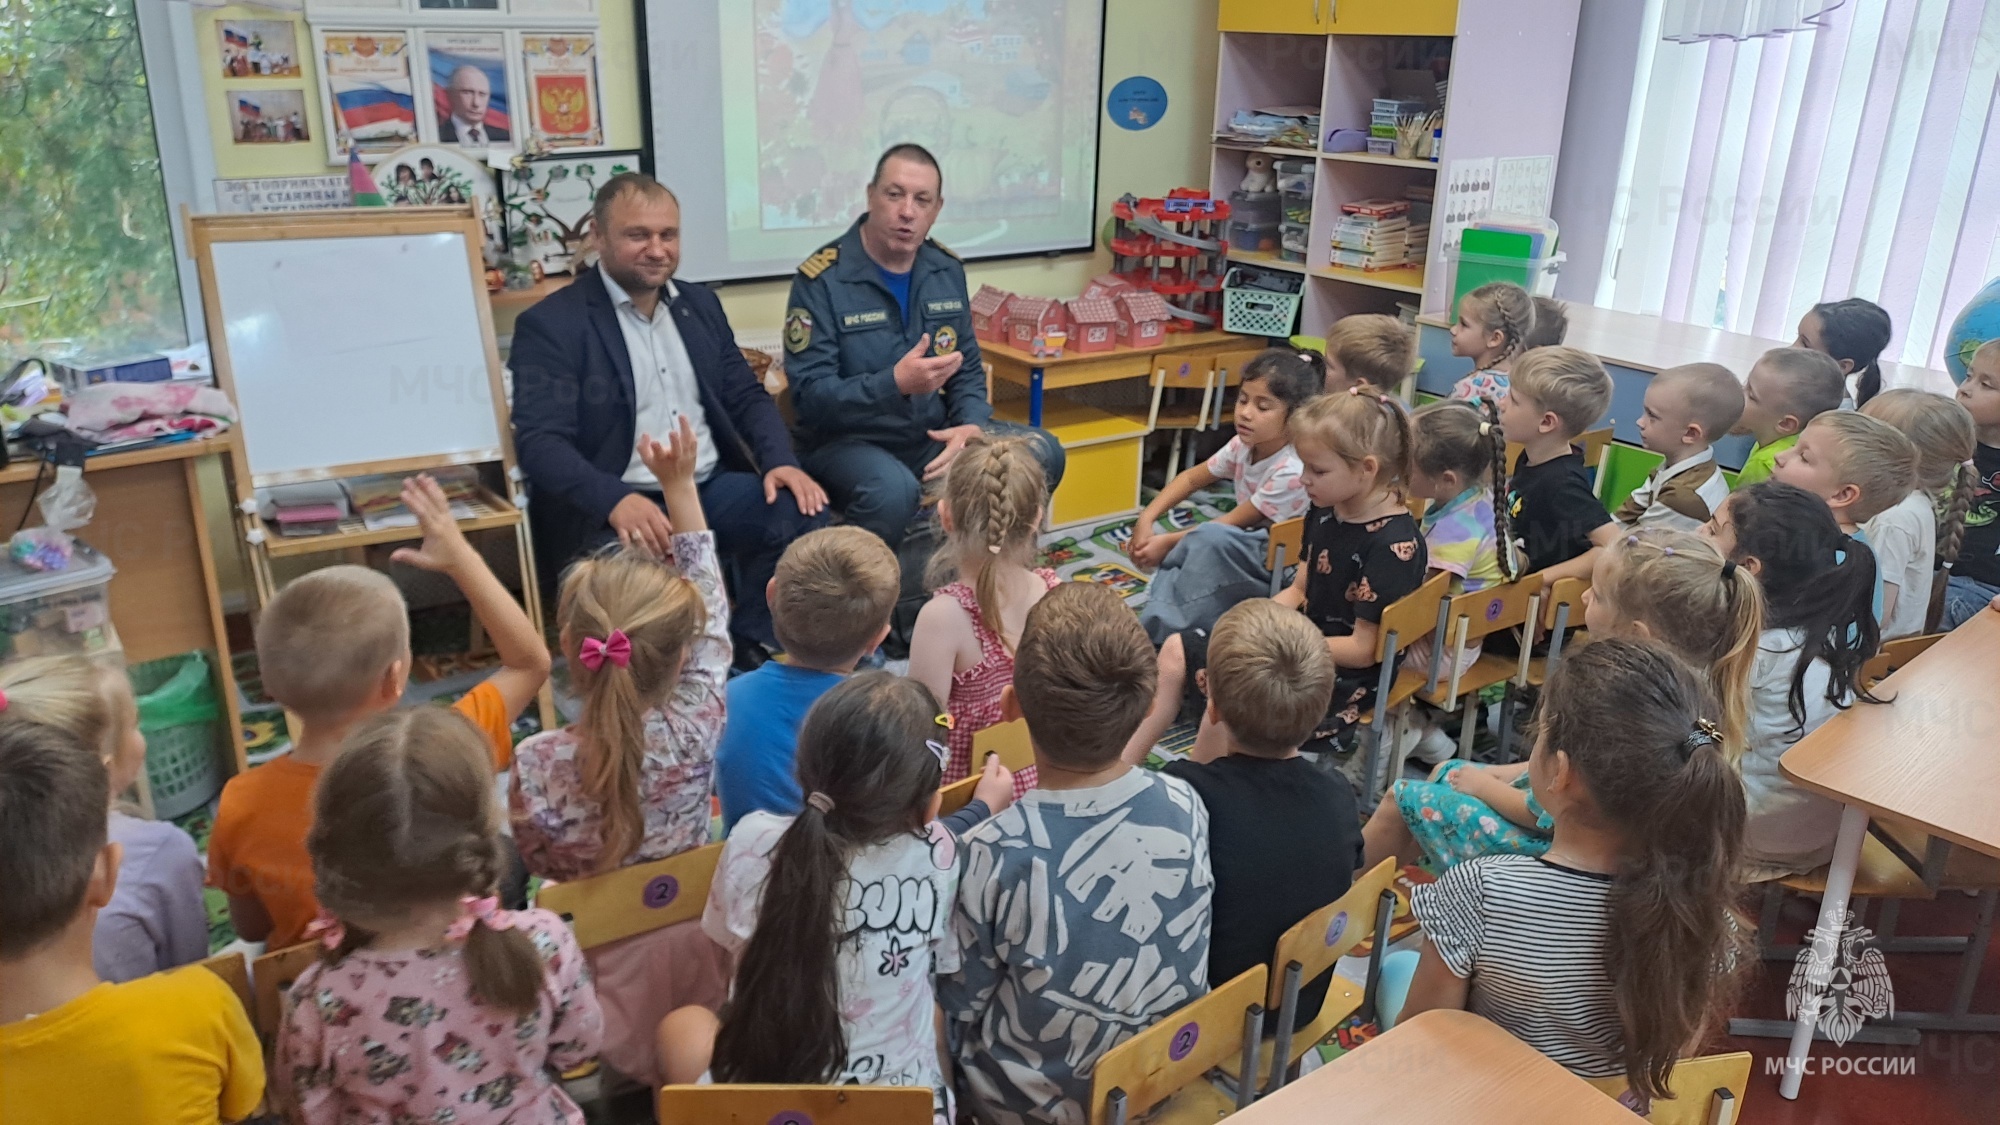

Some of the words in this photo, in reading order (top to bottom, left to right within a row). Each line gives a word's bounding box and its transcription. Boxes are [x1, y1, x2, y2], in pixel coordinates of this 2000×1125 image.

[1491, 603, 1498, 616] 2
[656, 882, 669, 900] 2
[1331, 919, 1341, 939] 2
[1178, 1031, 1191, 1053] 2
